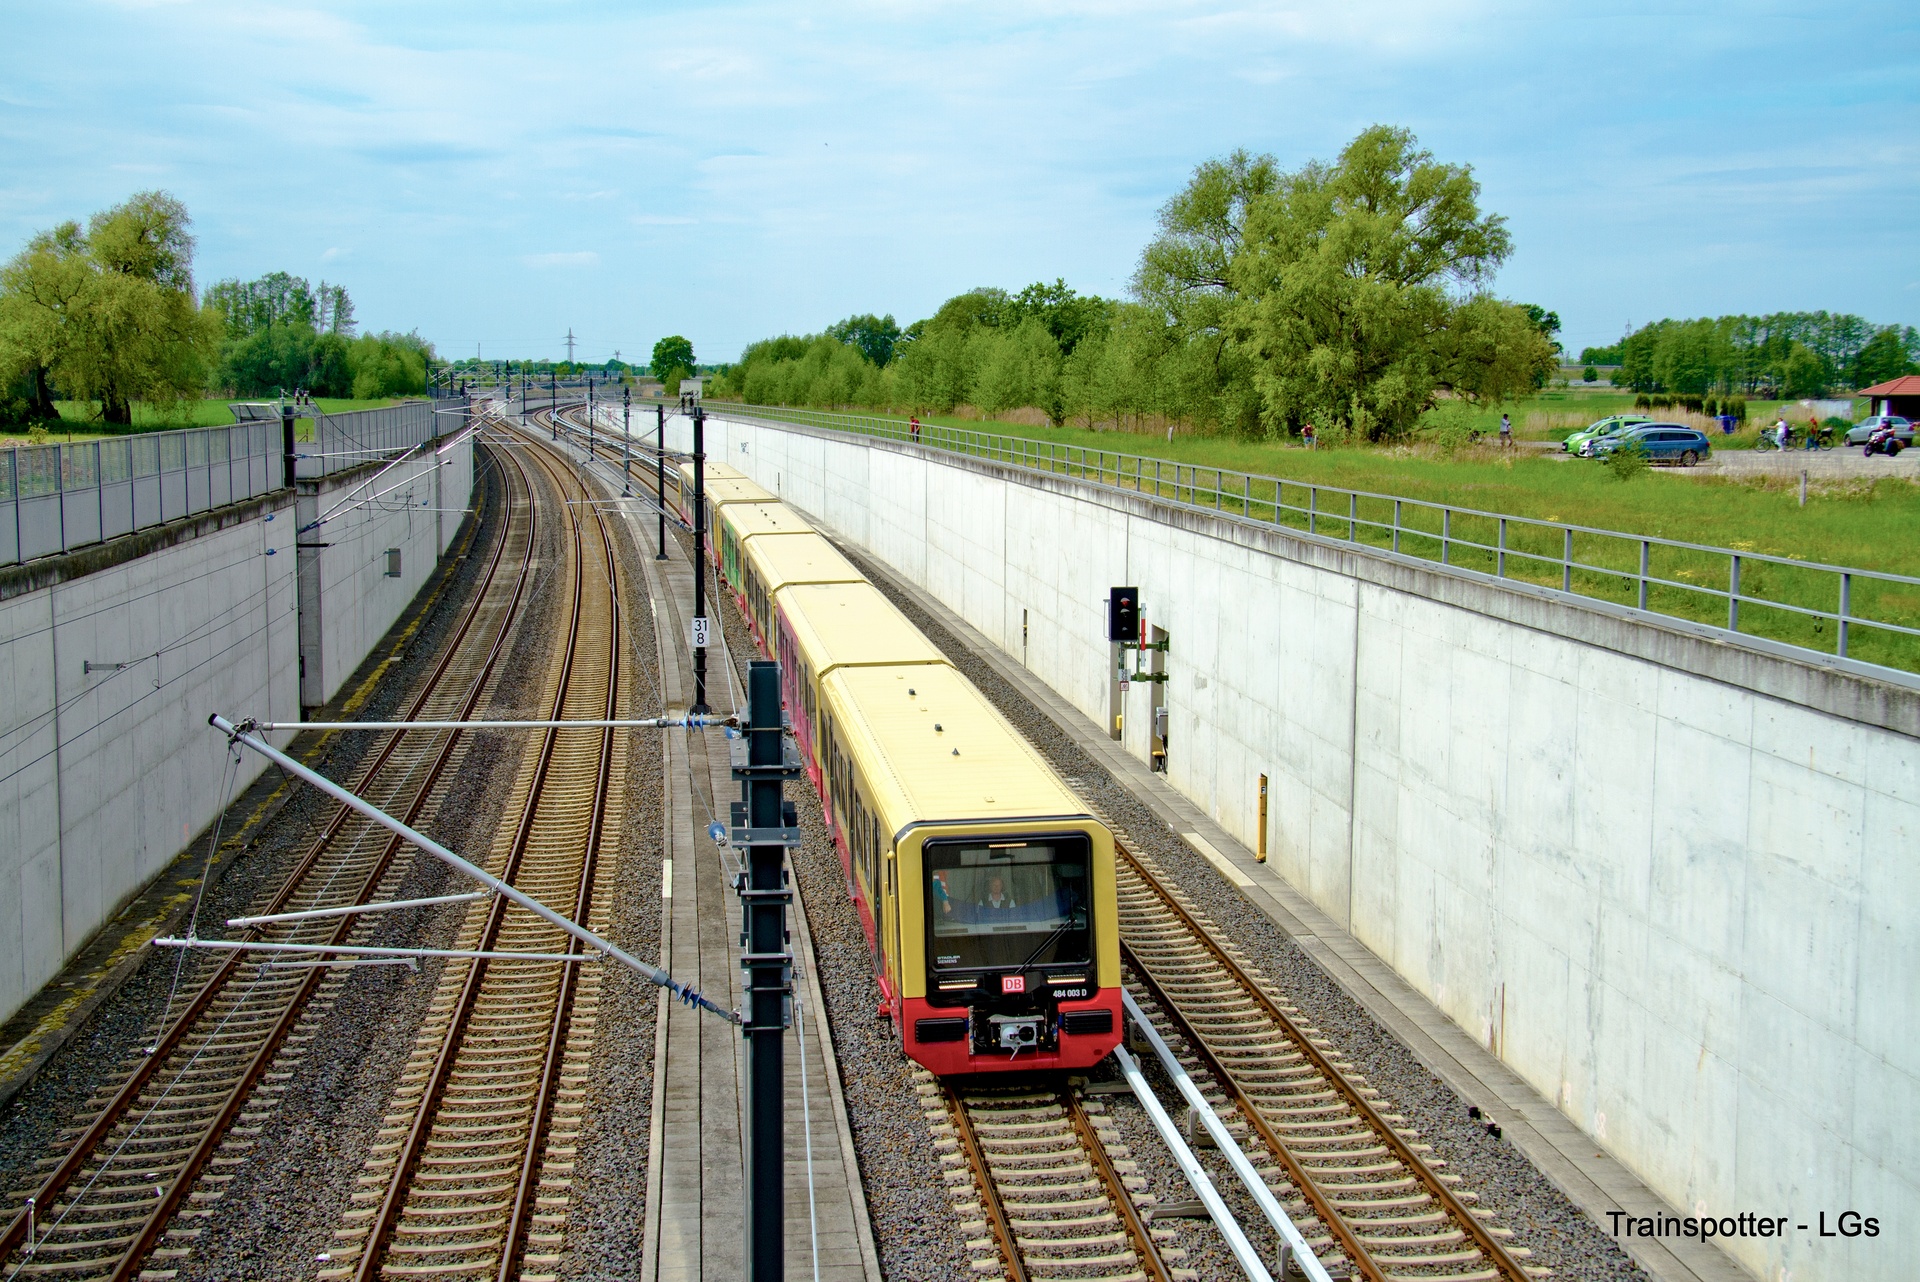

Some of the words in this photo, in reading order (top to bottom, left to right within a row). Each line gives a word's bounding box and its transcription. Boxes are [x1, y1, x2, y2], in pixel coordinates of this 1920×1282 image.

[694, 619, 707, 632] 31
[696, 632, 705, 645] 8
[1005, 978, 1022, 990] DB
[1053, 989, 1066, 998] 484
[1067, 988, 1080, 998] 003
[1081, 988, 1087, 997] D
